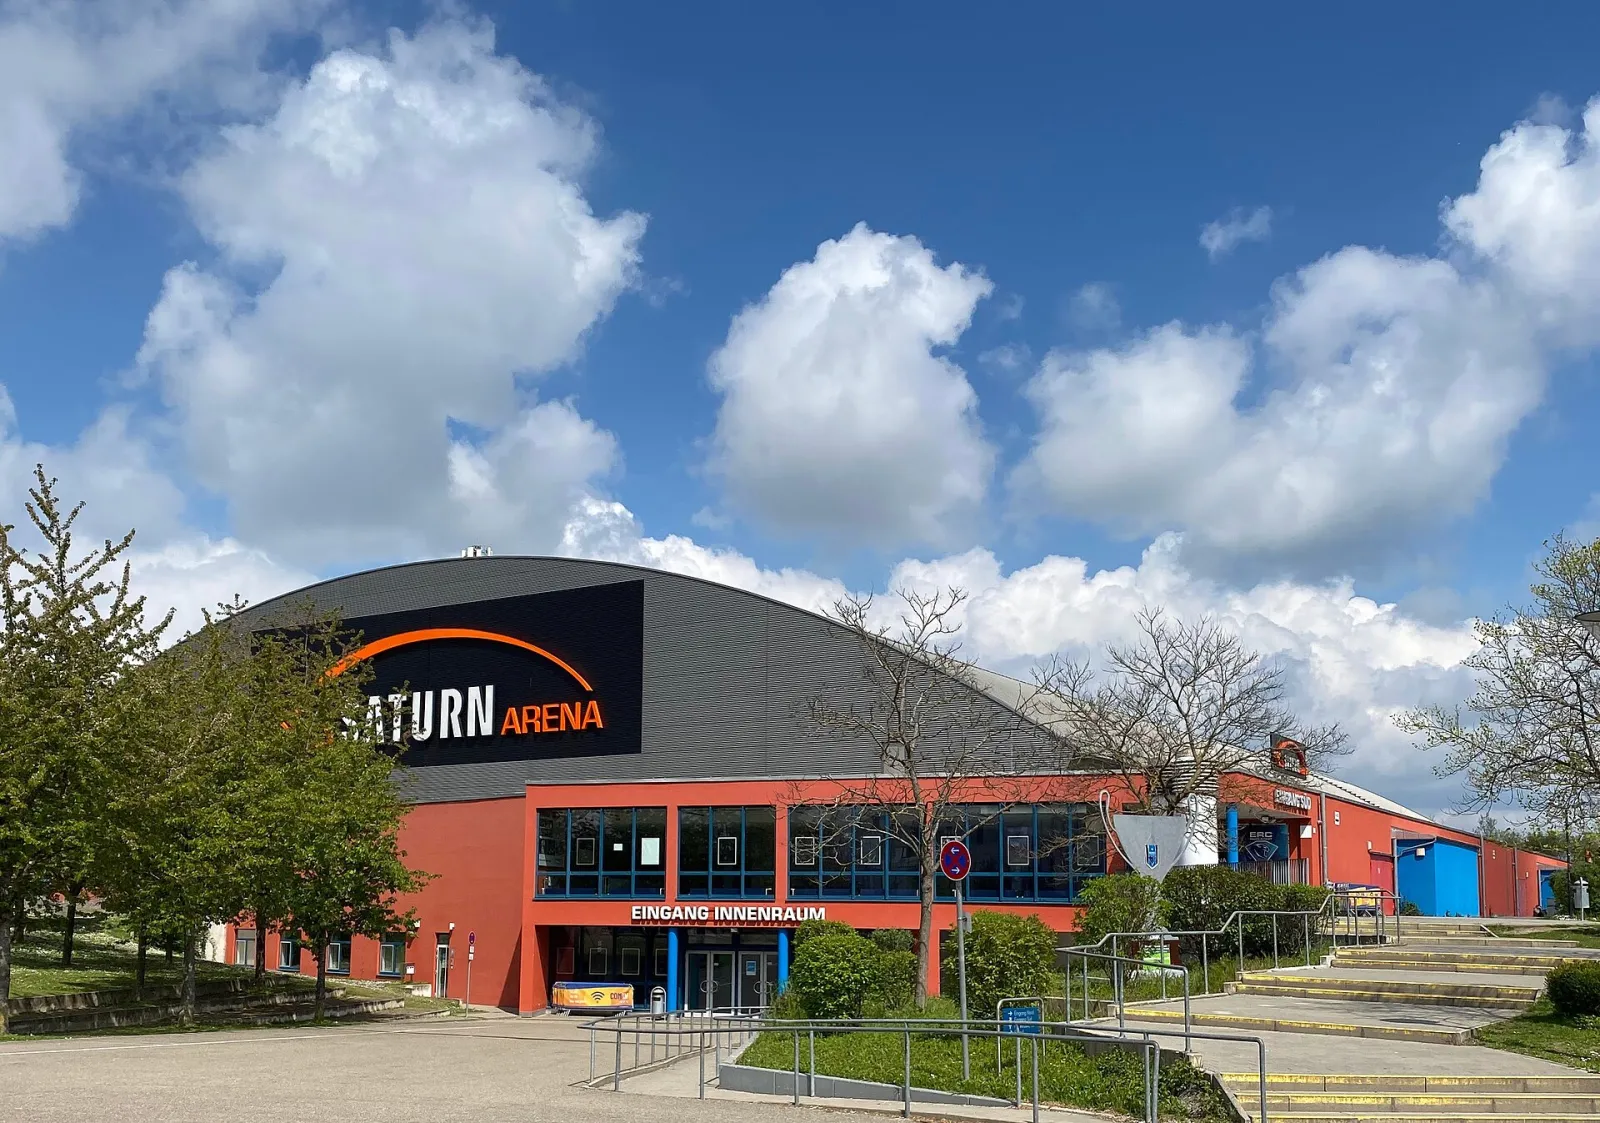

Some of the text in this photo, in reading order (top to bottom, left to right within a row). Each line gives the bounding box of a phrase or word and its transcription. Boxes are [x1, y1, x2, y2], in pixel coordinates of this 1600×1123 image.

[500, 700, 604, 735] ARENA
[631, 905, 826, 921] EINGANG INNENRAUM
